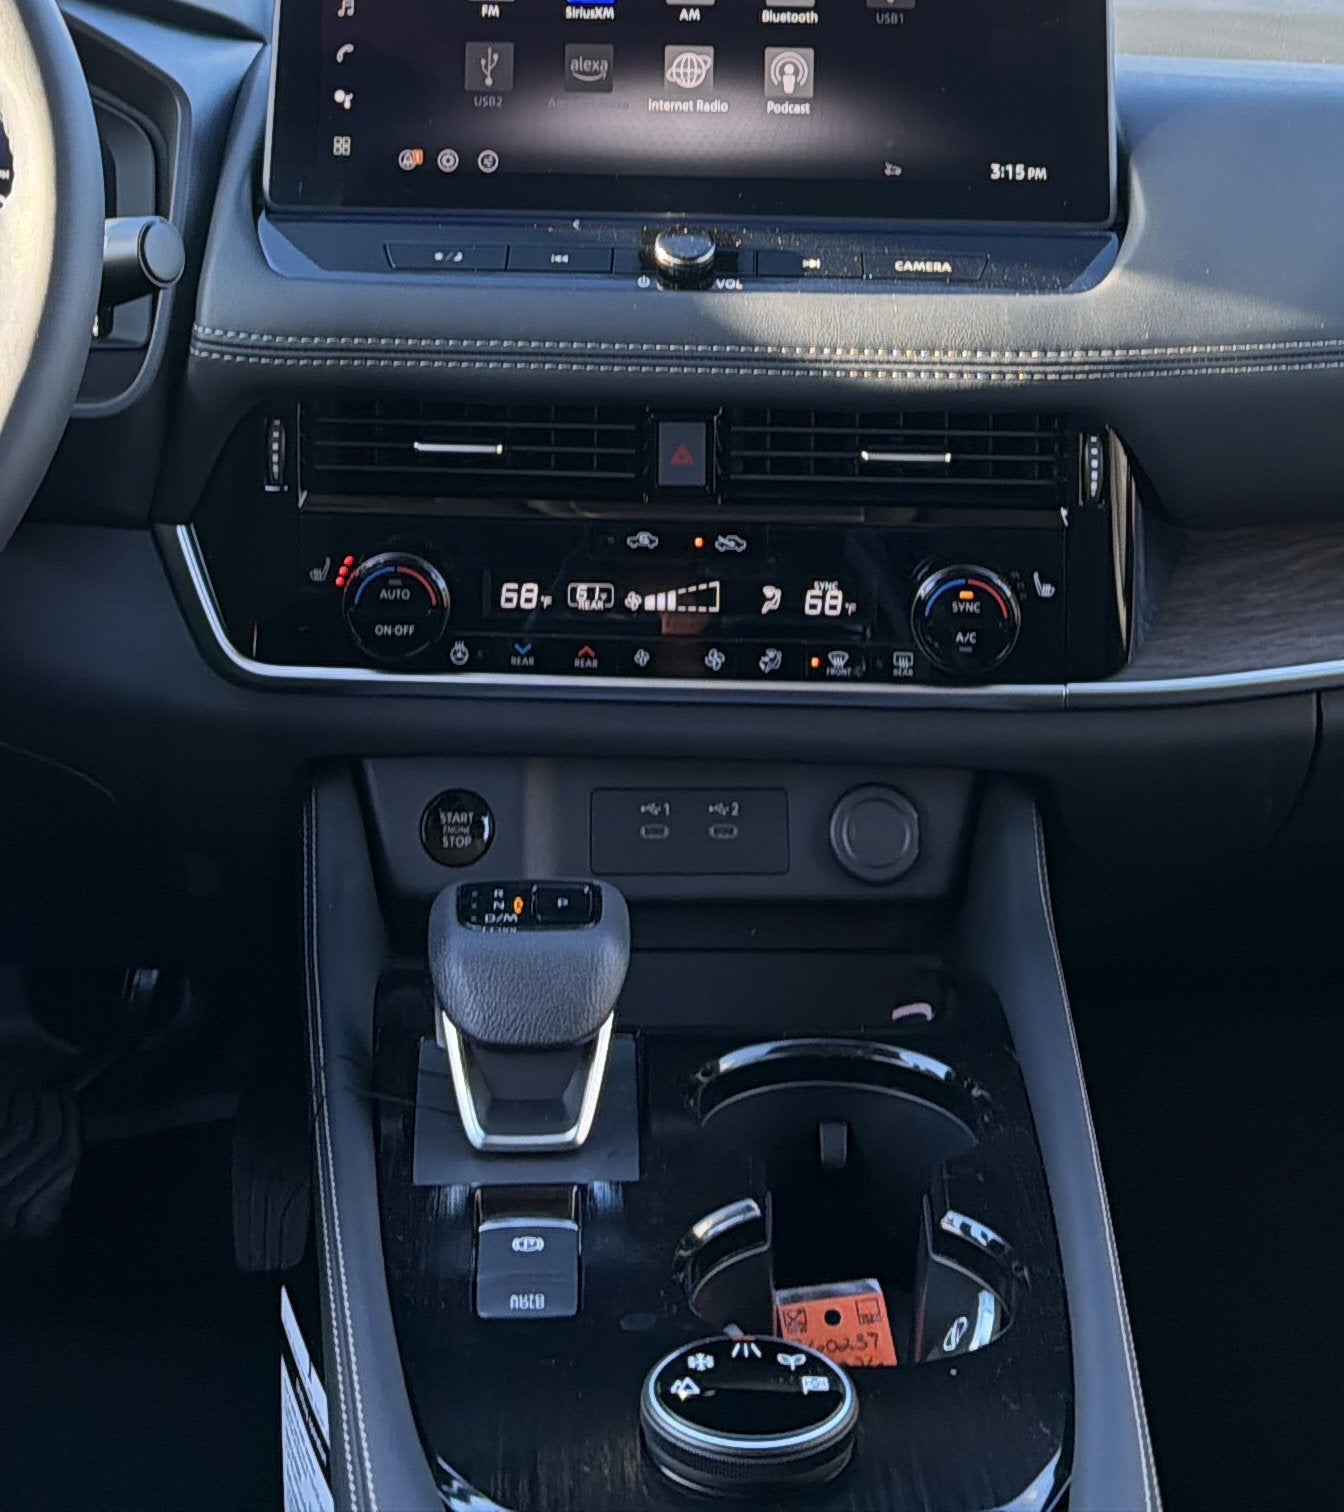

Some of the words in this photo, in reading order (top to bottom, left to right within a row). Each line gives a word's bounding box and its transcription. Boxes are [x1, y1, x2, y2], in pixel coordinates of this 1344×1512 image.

[481, 4, 500, 19] FM
[565, 6, 615, 20] SiriusXM
[679, 8, 701, 22] AM
[761, 9, 819, 24] Bluetooth
[876, 12, 904, 25] USB1
[570, 56, 609, 73] alexa
[474, 96, 503, 108] USB2
[648, 98, 693, 112] Internet
[696, 99, 729, 113] Radio
[766, 101, 810, 115] Podcast
[990, 163, 1025, 181] 3:15
[1027, 166, 1047, 181] PM
[894, 260, 953, 273] CAMERA
[716, 278, 743, 290] VOL
[379, 589, 411, 601] AUTO
[952, 601, 981, 614] SYNC
[956, 631, 977, 644] A/C
[510, 655, 535, 667] REAR
[574, 657, 598, 669] REAR
[663, 802, 670, 816] 1
[731, 801, 739, 816] 2
[439, 811, 474, 825] START
[442, 836, 472, 848] STOP
[493, 902, 505, 910] N
[558, 897, 568, 908] P
[485, 913, 518, 923] D/M
